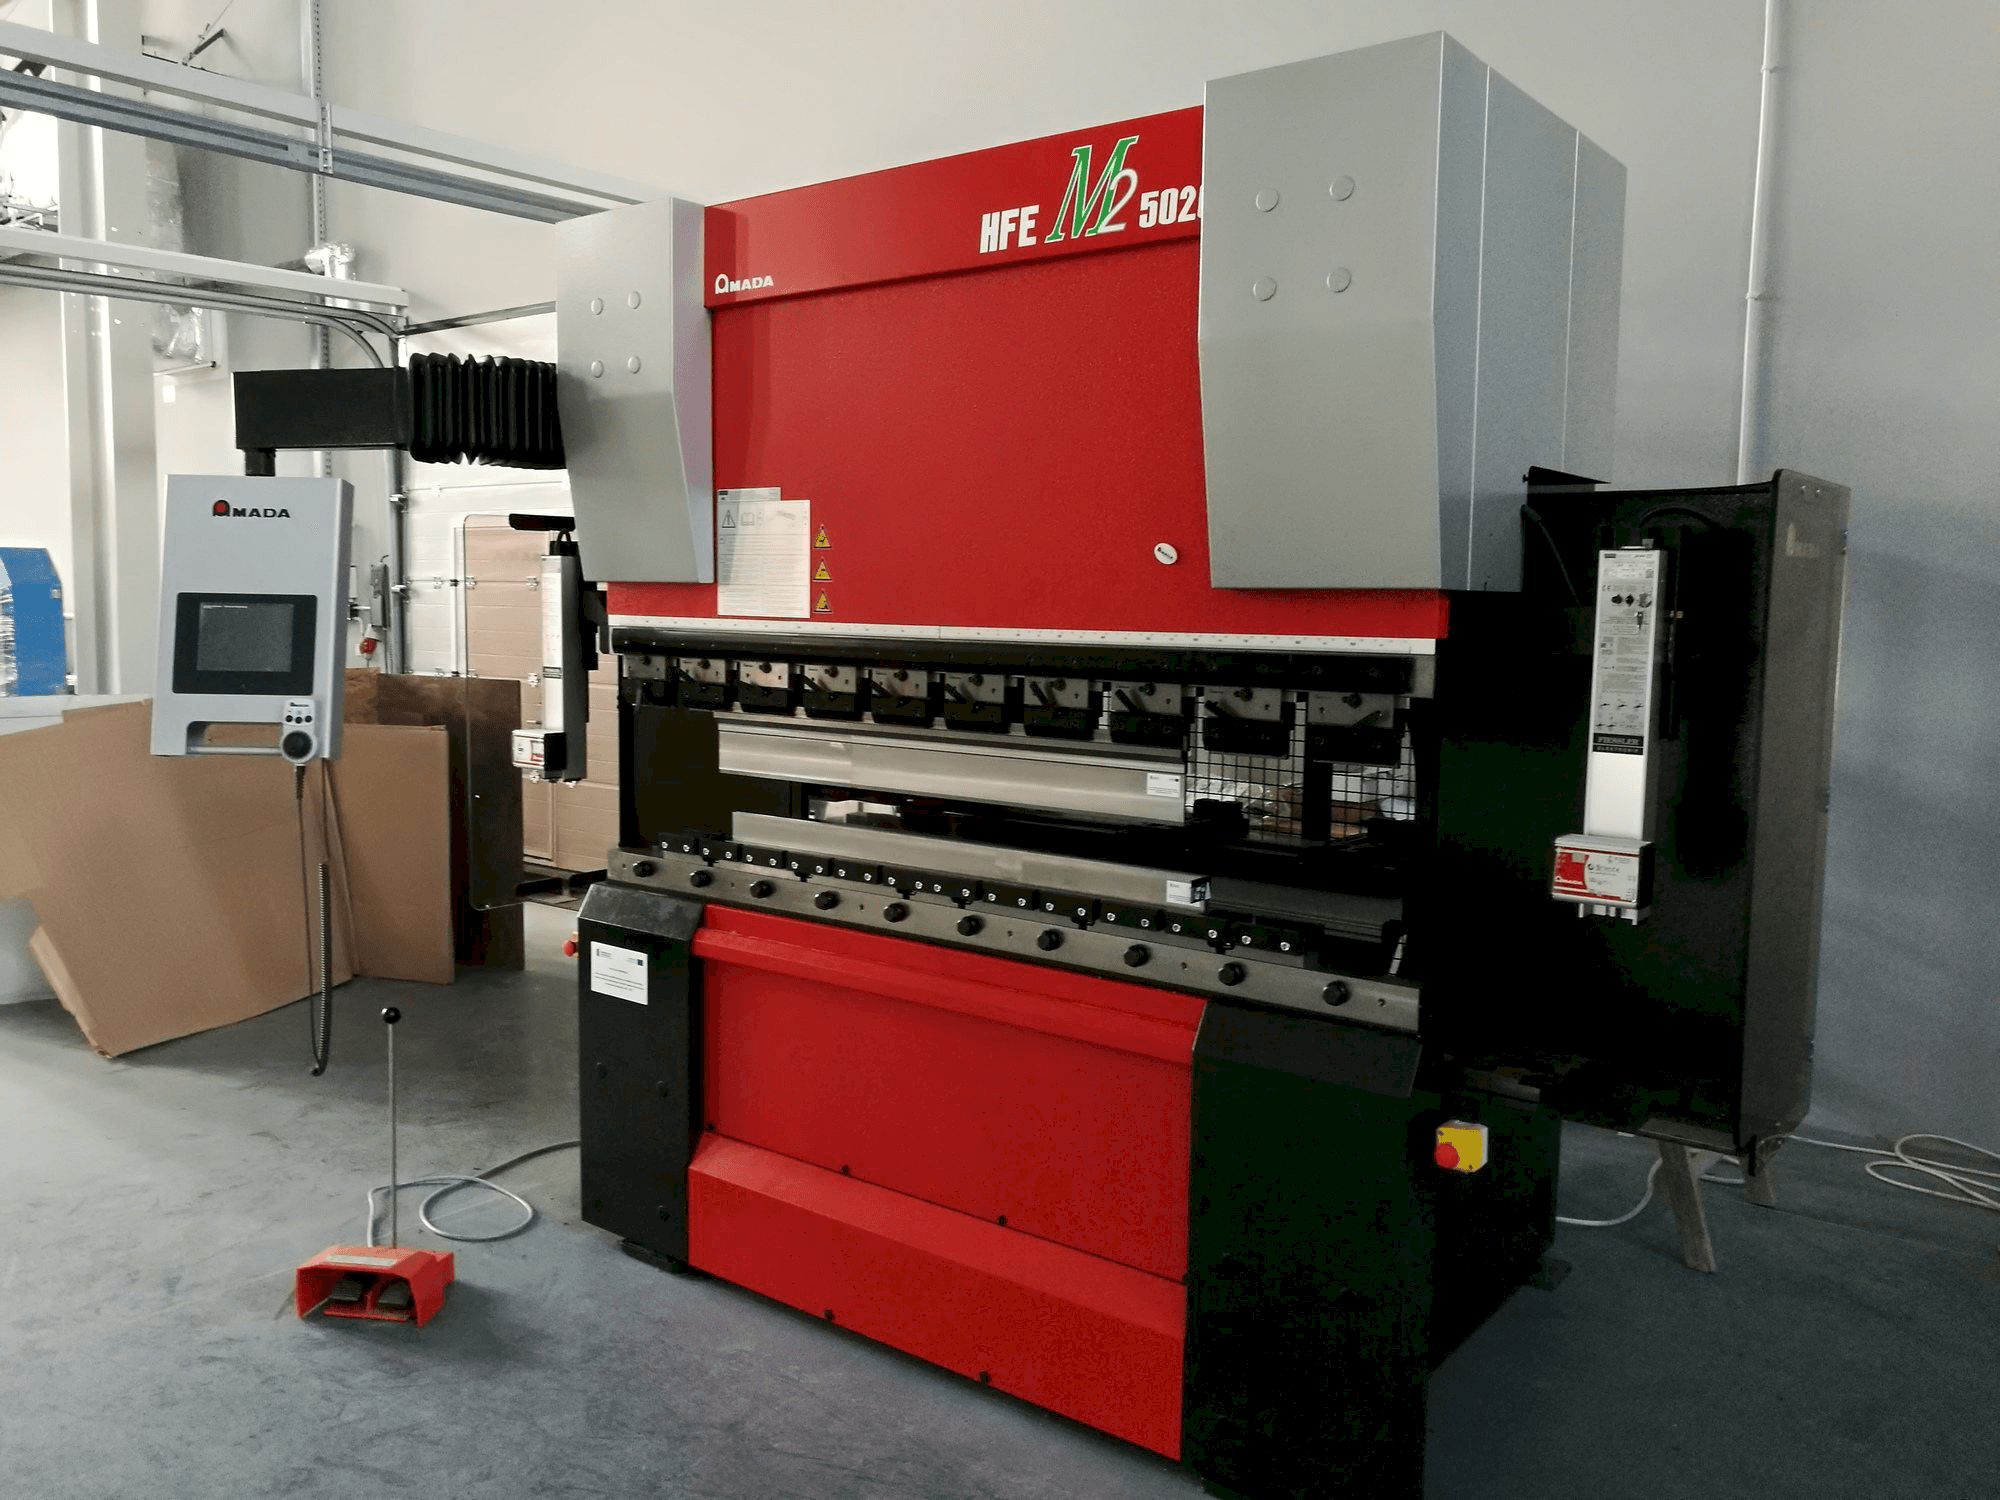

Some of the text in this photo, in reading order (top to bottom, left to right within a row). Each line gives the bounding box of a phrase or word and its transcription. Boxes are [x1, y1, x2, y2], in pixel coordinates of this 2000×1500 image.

[979, 205, 1040, 253] HFE
[715, 273, 774, 295] AMADA
[212, 499, 291, 518] AMADA
